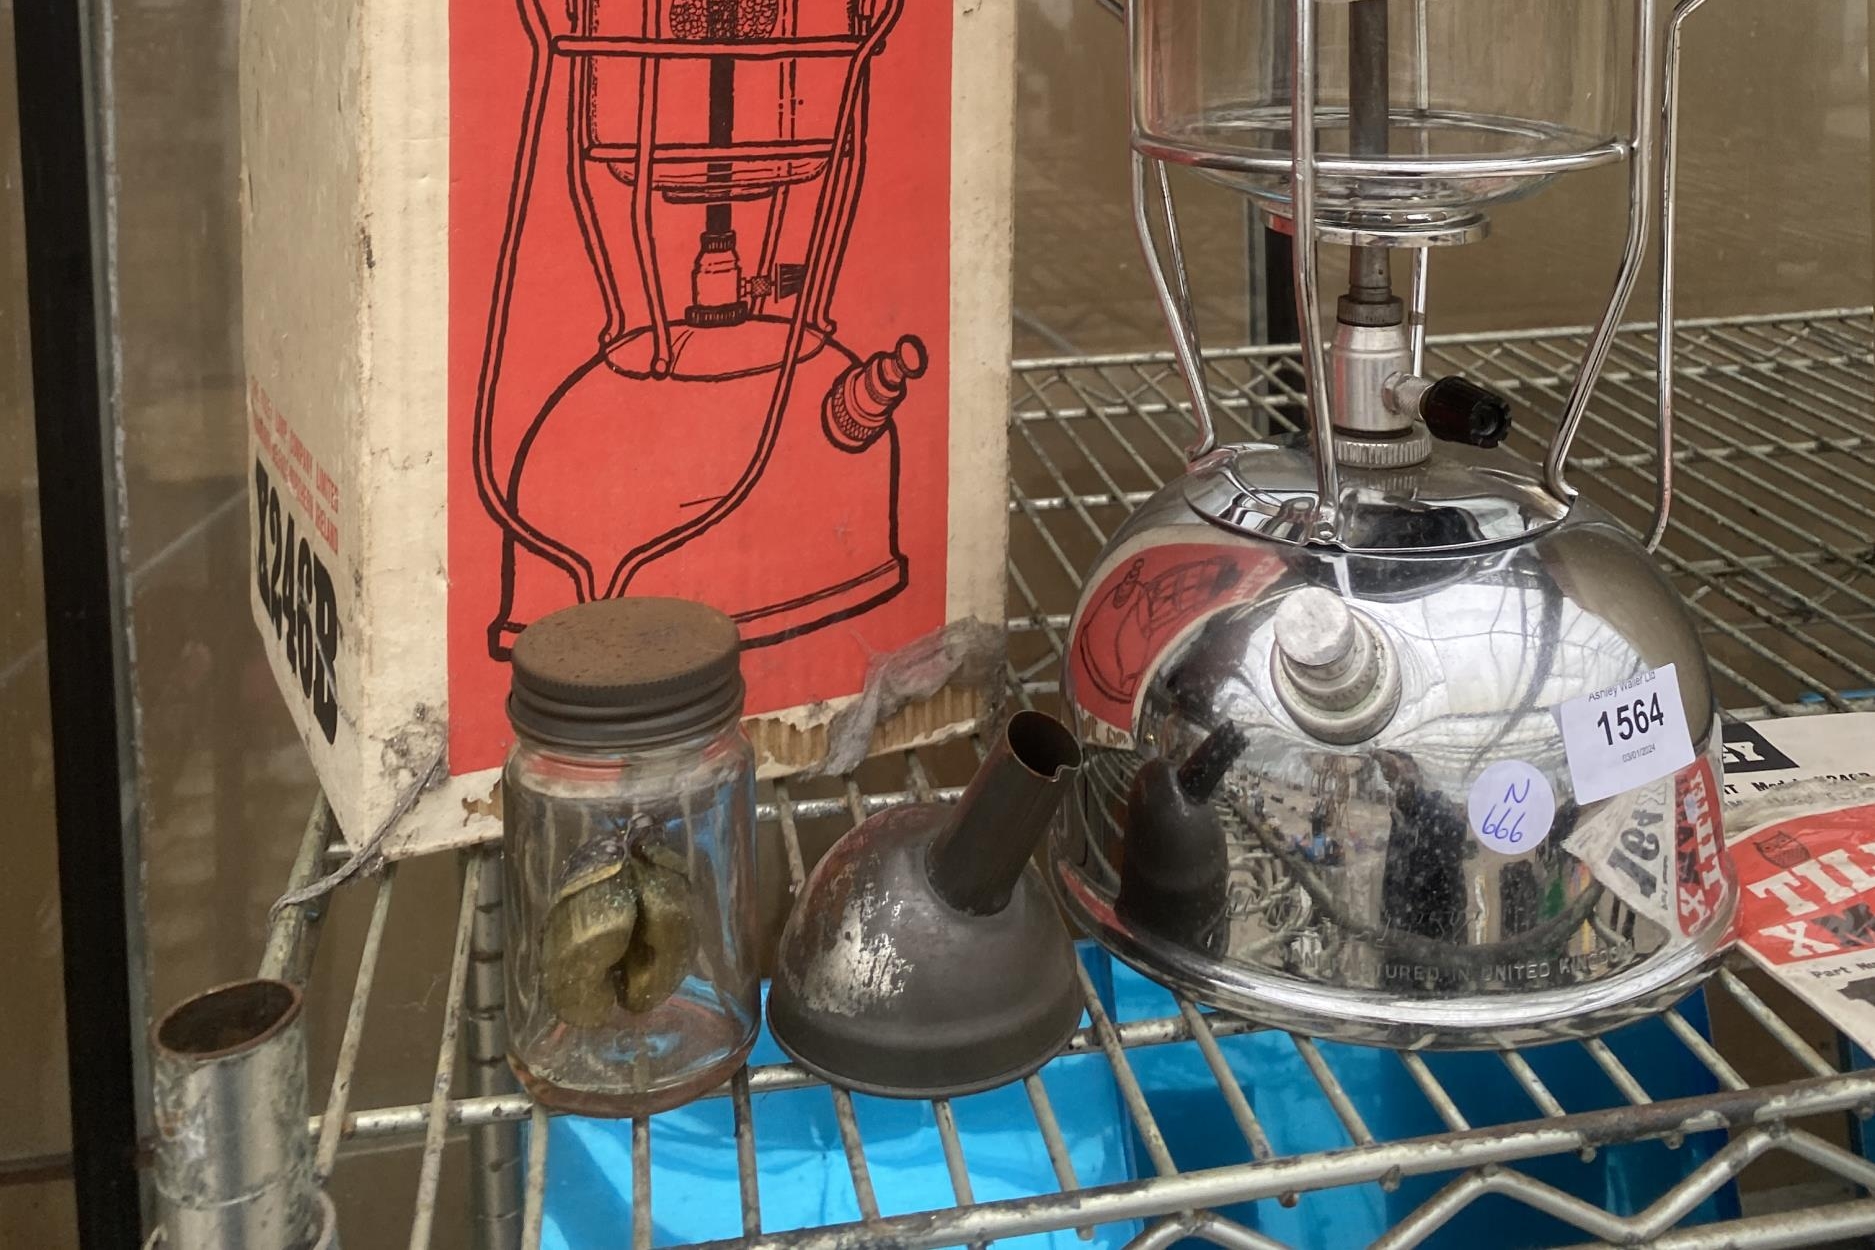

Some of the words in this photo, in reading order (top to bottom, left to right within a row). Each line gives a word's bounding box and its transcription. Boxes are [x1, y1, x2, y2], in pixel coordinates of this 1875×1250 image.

[1597, 692, 1664, 746] 1564
[1503, 778, 1529, 804] N
[1482, 803, 1526, 843] 666
[1480, 961, 1550, 983] UNITED
[1810, 966, 1852, 979] Part
